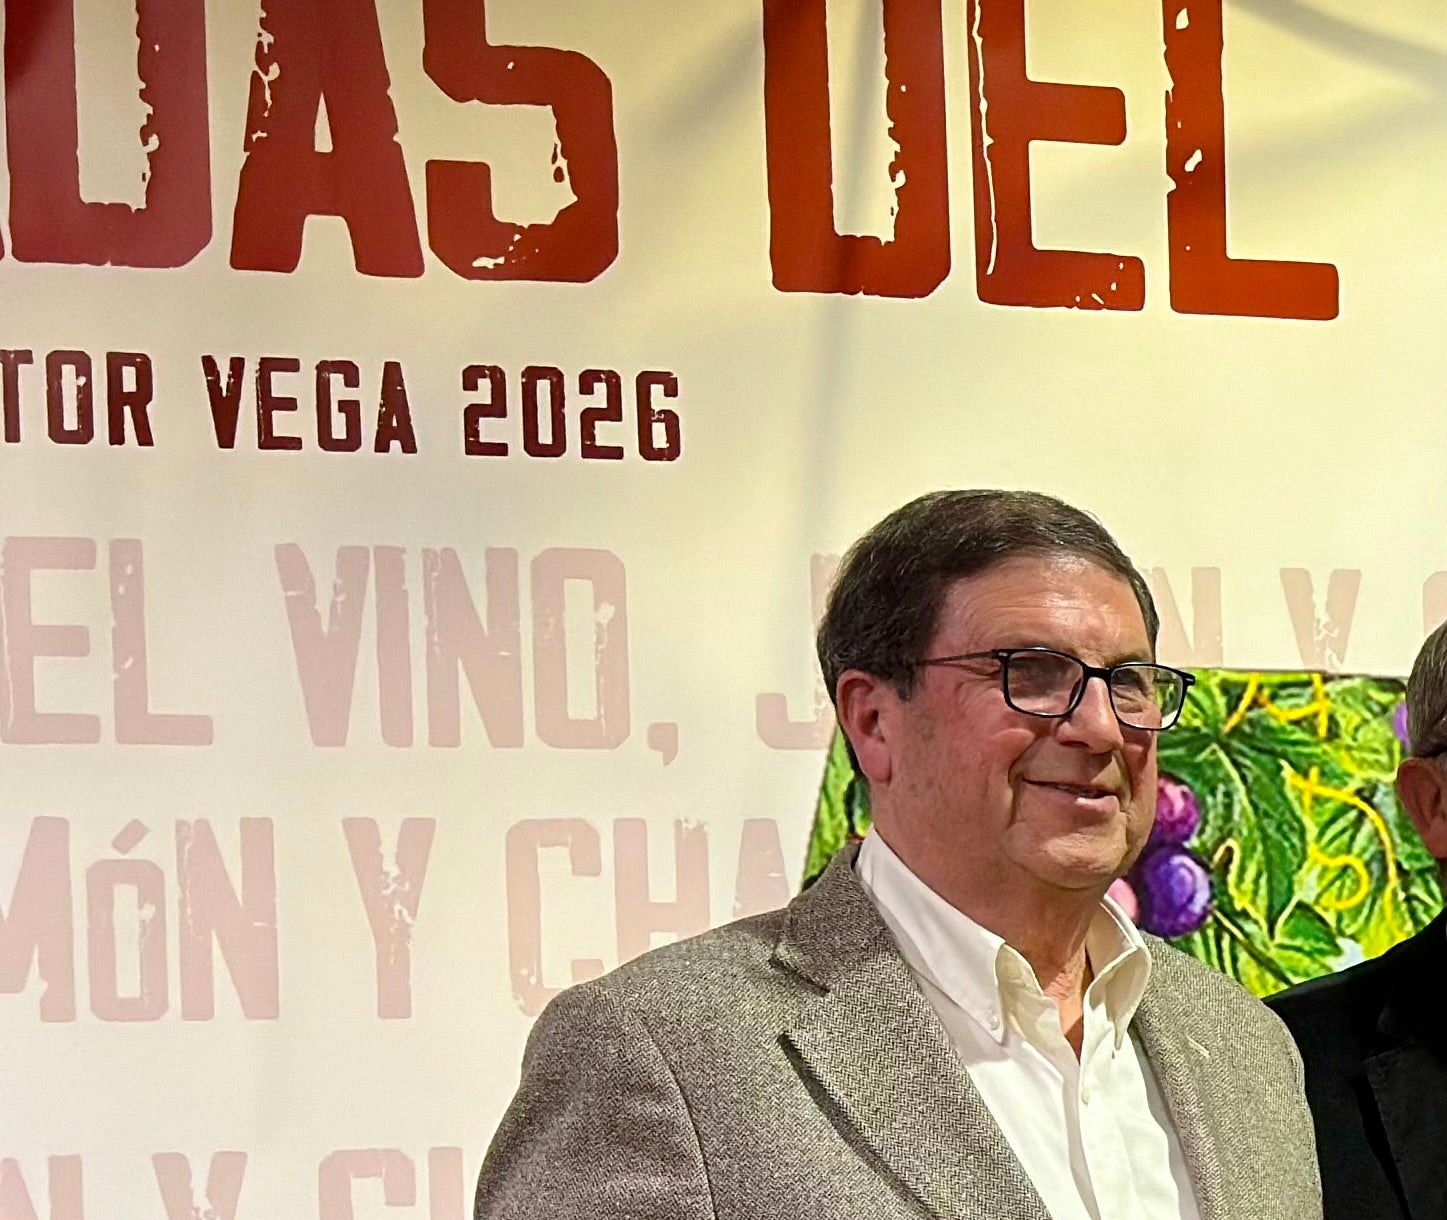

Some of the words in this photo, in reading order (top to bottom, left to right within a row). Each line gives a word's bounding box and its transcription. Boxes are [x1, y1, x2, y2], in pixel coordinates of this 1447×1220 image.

[0, 0, 618, 283] DAS
[762, 0, 1339, 321] DEL
[202, 354, 418, 454] VEGA
[462, 363, 682, 462] 2026
[275, 542, 679, 766] VINO,
[342, 816, 437, 1020] Y
